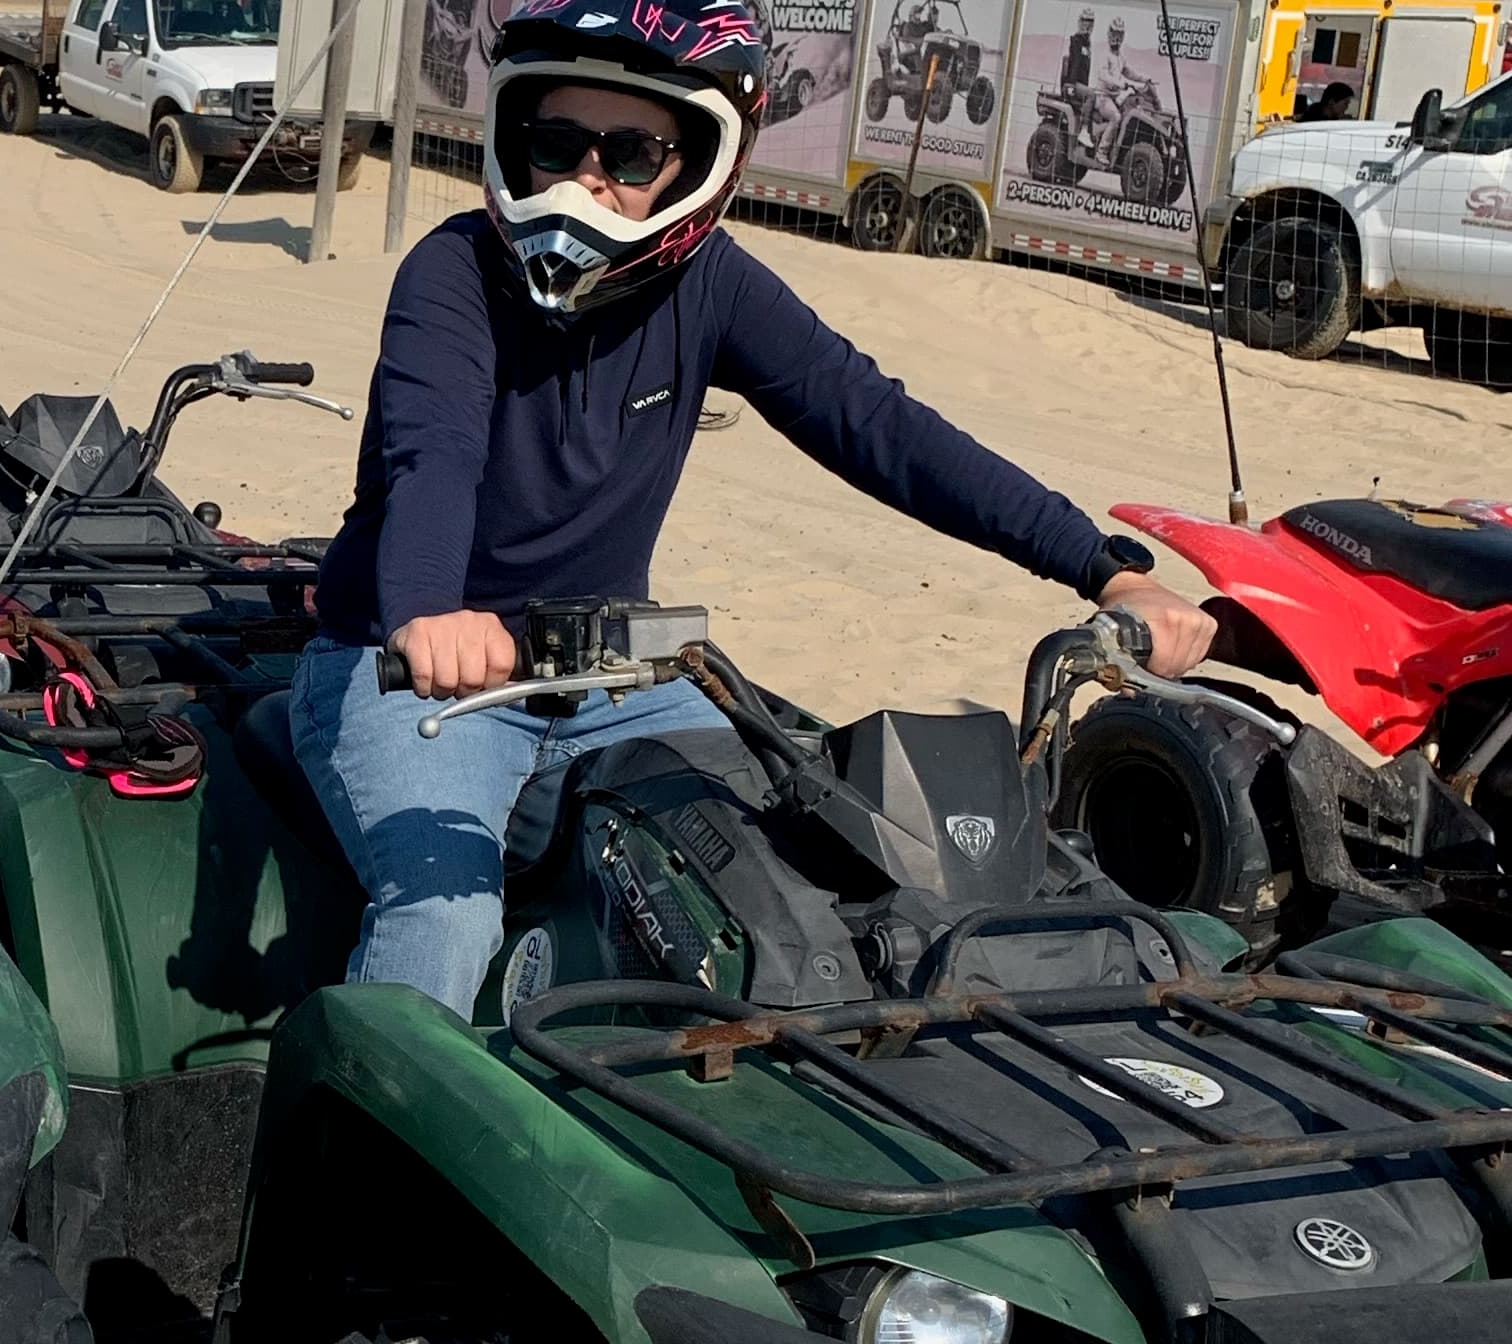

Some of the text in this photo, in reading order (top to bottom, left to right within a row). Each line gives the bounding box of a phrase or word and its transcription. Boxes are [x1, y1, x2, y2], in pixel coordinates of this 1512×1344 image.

[773, 7, 854, 33] WELCOME
[1178, 17, 1220, 35] PERFECT
[1191, 33, 1214, 48] FOR
[921, 135, 952, 154] GOOD
[1007, 181, 1075, 210] 2-PERSON
[1149, 204, 1194, 231] DRIVE
[1299, 513, 1373, 566] HONDA
[674, 803, 731, 872] YAMAHA
